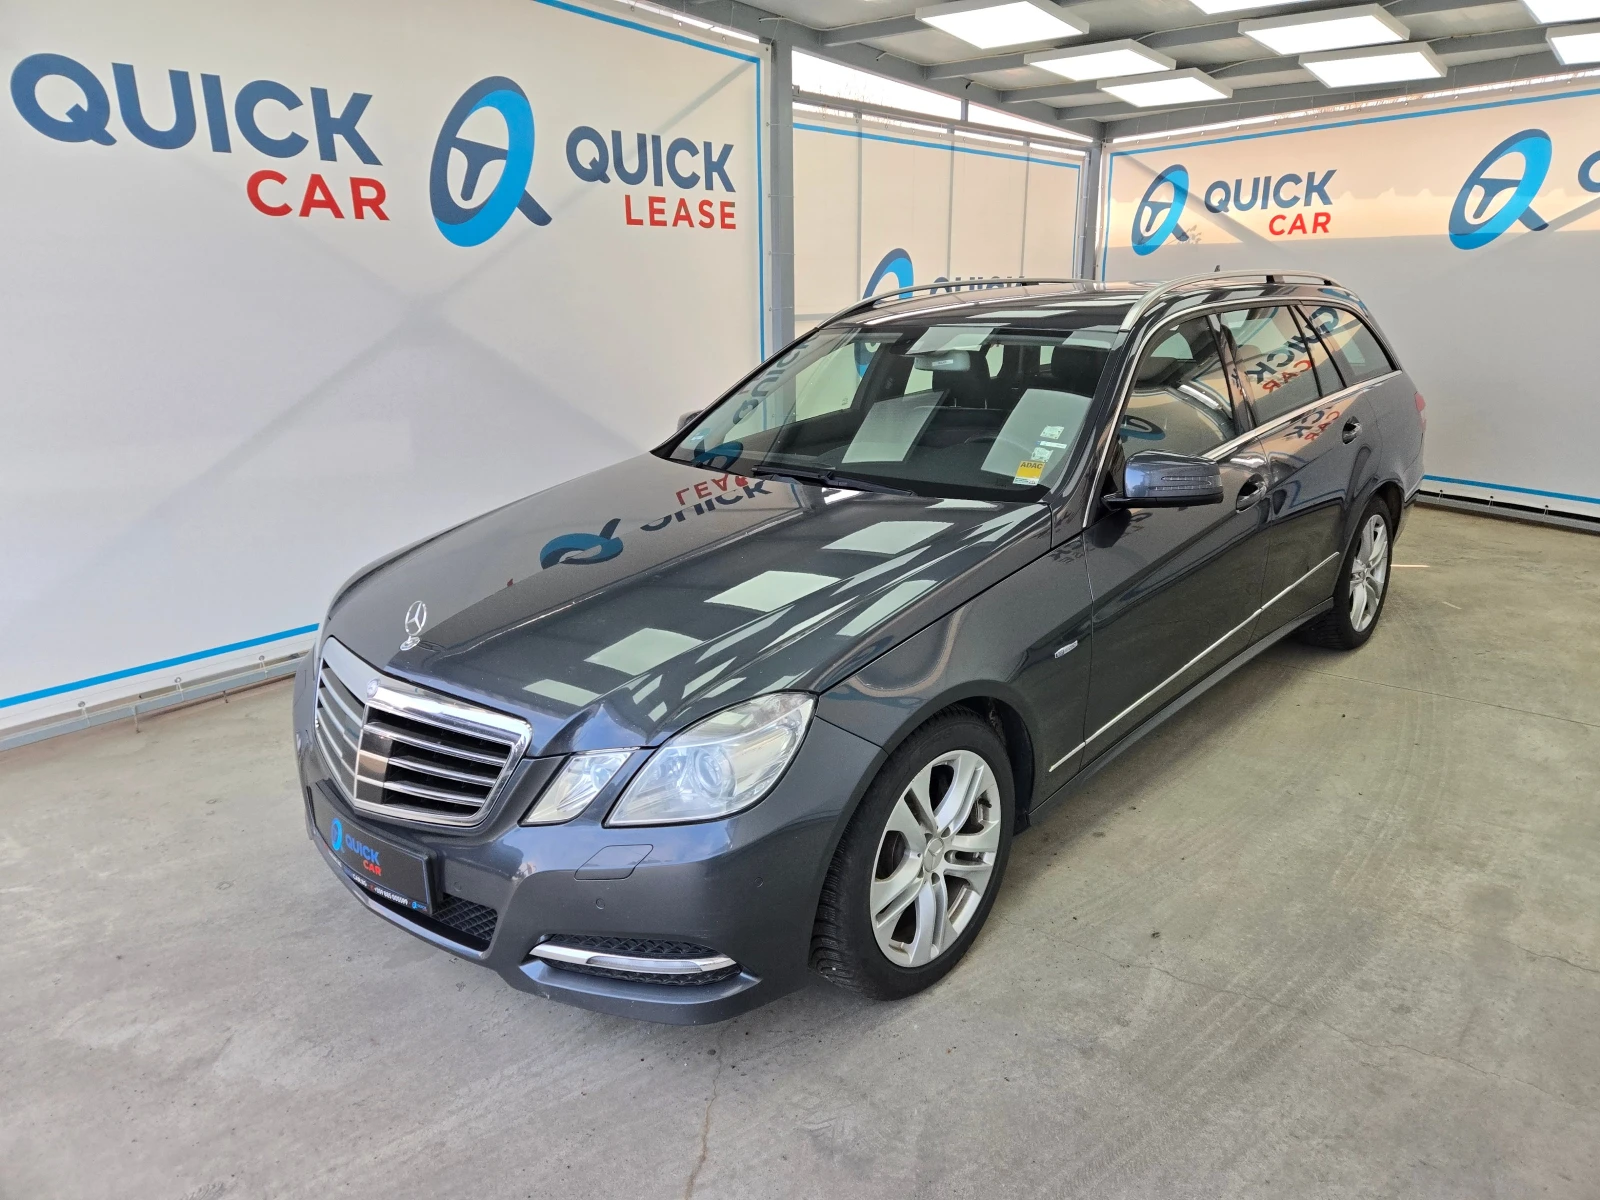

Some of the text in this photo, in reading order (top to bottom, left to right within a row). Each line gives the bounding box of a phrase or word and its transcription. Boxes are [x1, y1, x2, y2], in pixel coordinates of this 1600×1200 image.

[10, 53, 382, 166] QUICK
[565, 125, 736, 193] QUICK
[246, 169, 390, 222] CAR
[1204, 169, 1337, 213] QUICK
[624, 194, 737, 231] LEASE
[1268, 211, 1331, 237] CAR
[1020, 461, 1043, 469] ADAC
[345, 834, 380, 865] QUICK
[363, 860, 382, 877] CAR
